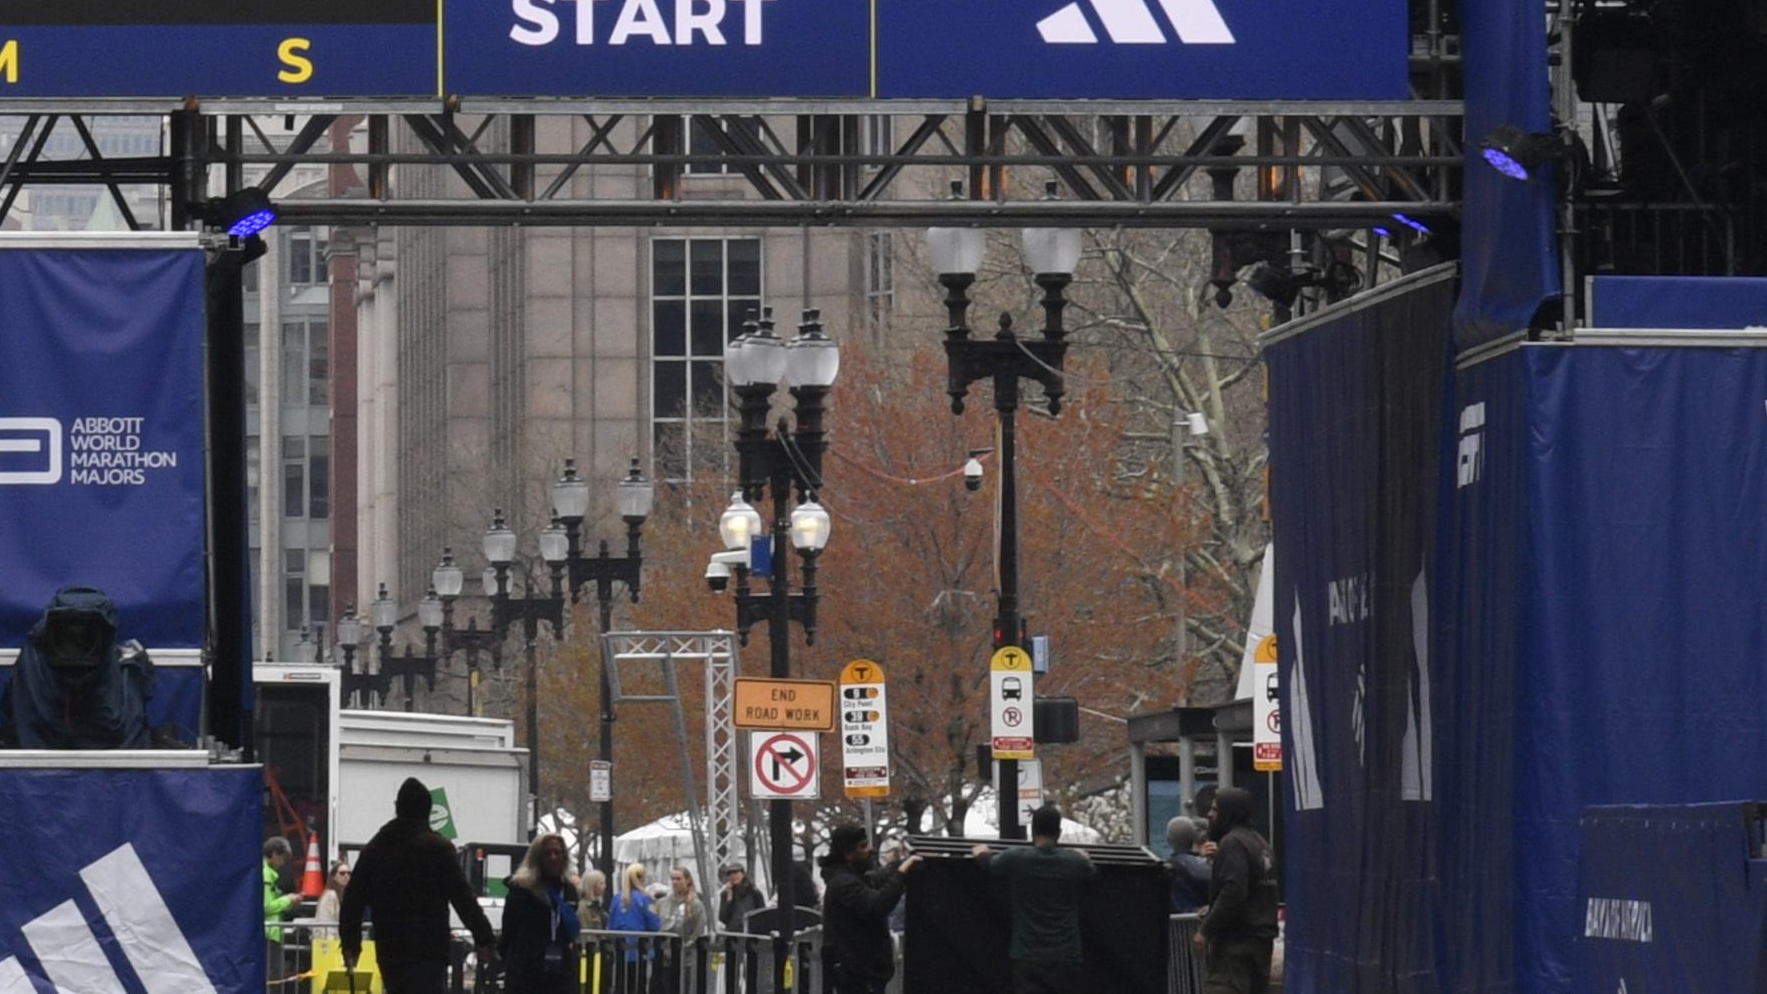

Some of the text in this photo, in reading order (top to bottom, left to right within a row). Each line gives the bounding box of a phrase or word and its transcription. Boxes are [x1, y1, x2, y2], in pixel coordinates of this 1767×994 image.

[277, 37, 313, 83] S
[70, 417, 144, 433] ABBOTT
[70, 434, 140, 451] WORLD
[70, 452, 176, 467] MARATHON
[70, 468, 145, 485] MAJORS
[771, 688, 796, 703] END
[745, 706, 820, 721] ROAD WORK
